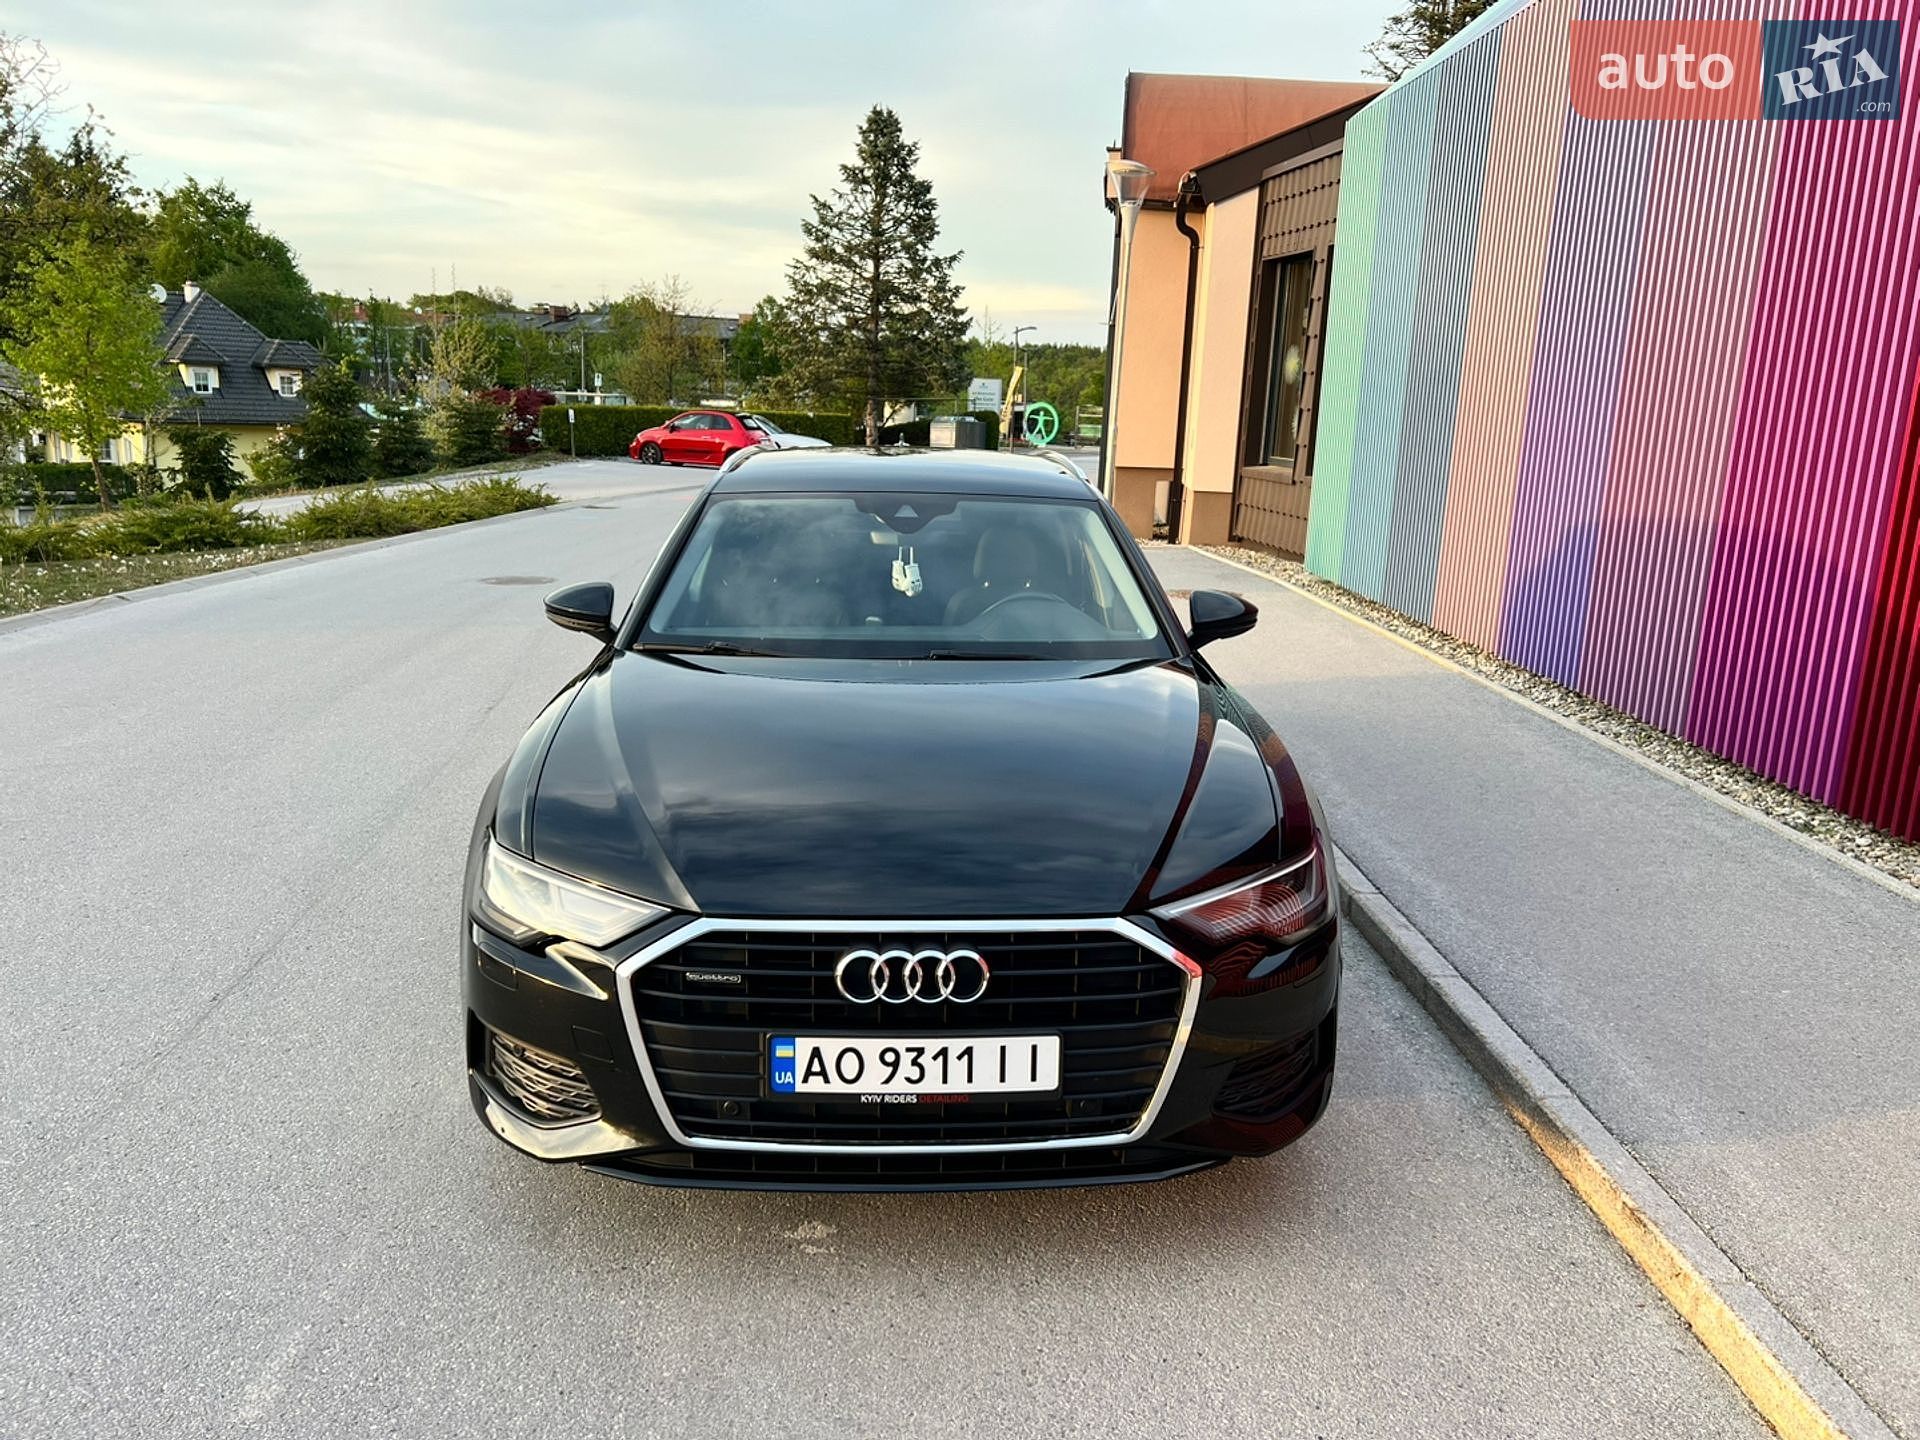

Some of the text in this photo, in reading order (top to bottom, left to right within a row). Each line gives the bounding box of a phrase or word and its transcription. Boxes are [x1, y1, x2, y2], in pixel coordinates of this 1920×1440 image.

[801, 1046, 865, 1085] AO
[878, 1046, 974, 1085] 9311
[775, 1071, 794, 1084] UA
[860, 1094, 882, 1103] KYIV
[883, 1094, 917, 1103] RIDERS
